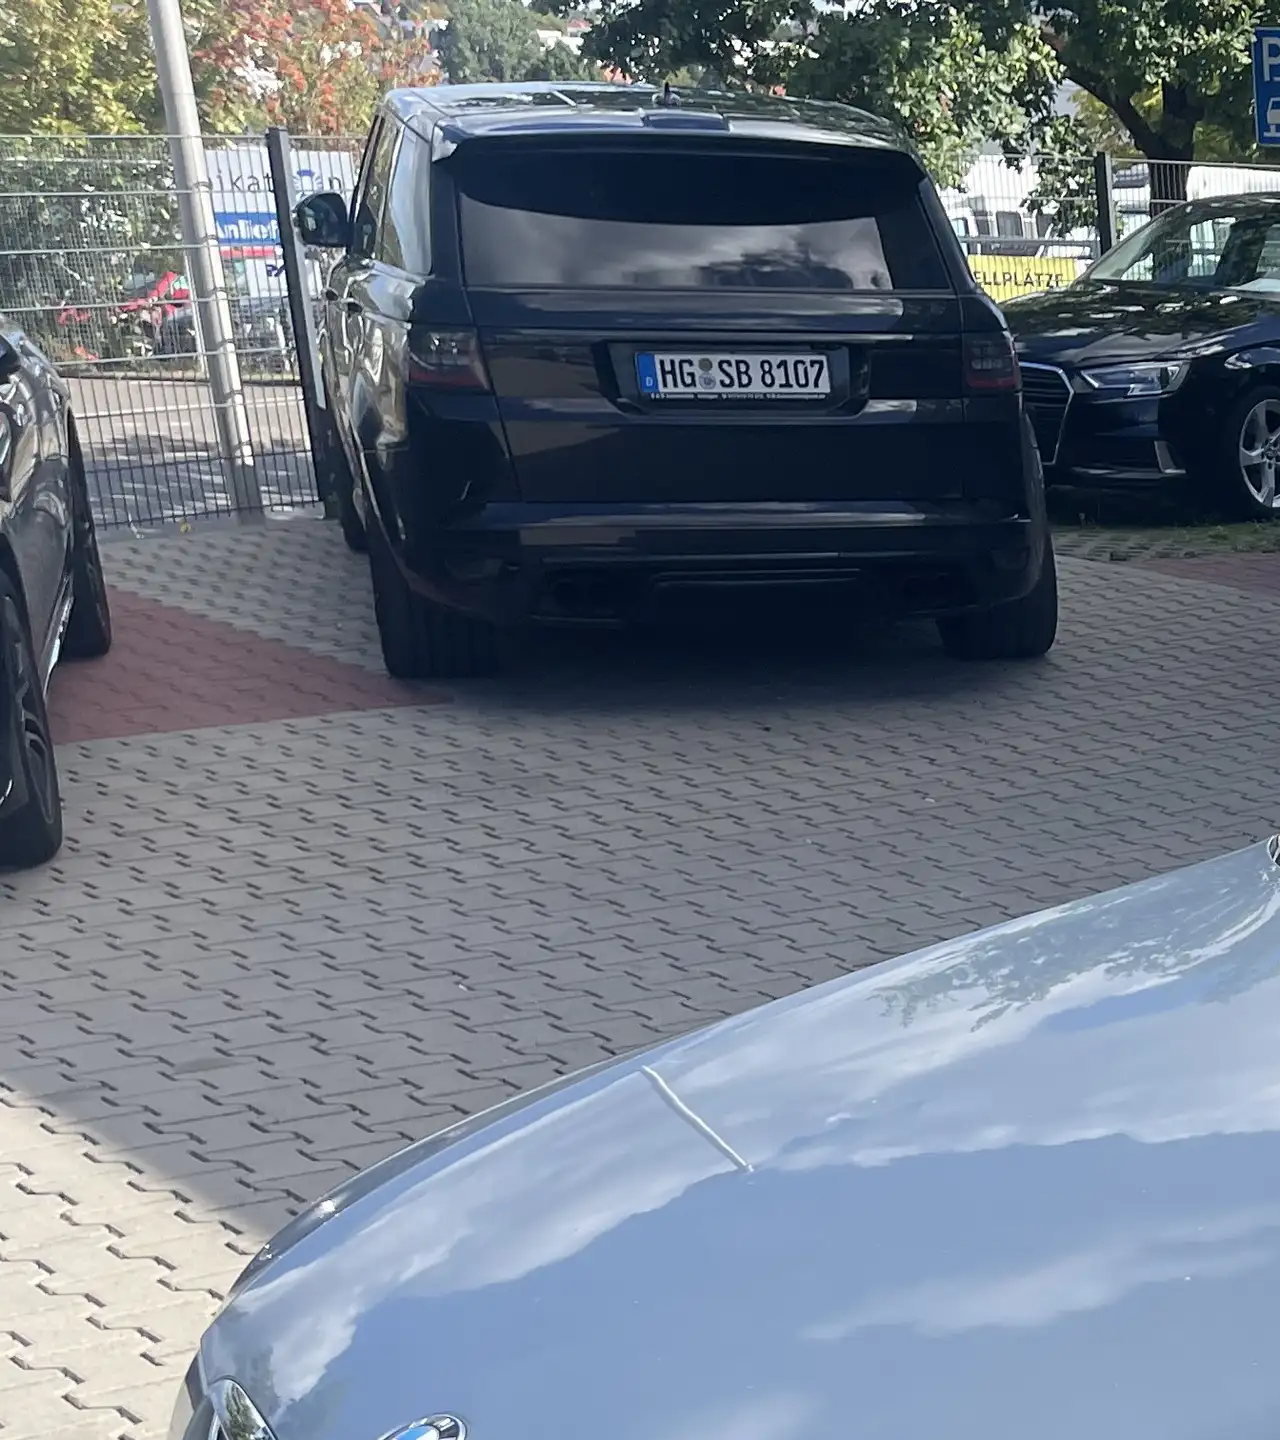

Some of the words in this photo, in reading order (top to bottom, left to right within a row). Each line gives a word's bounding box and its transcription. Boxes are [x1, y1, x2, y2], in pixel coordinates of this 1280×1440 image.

[659, 358, 697, 388] HG
[717, 359, 752, 389] SB
[760, 359, 825, 388] 8107
